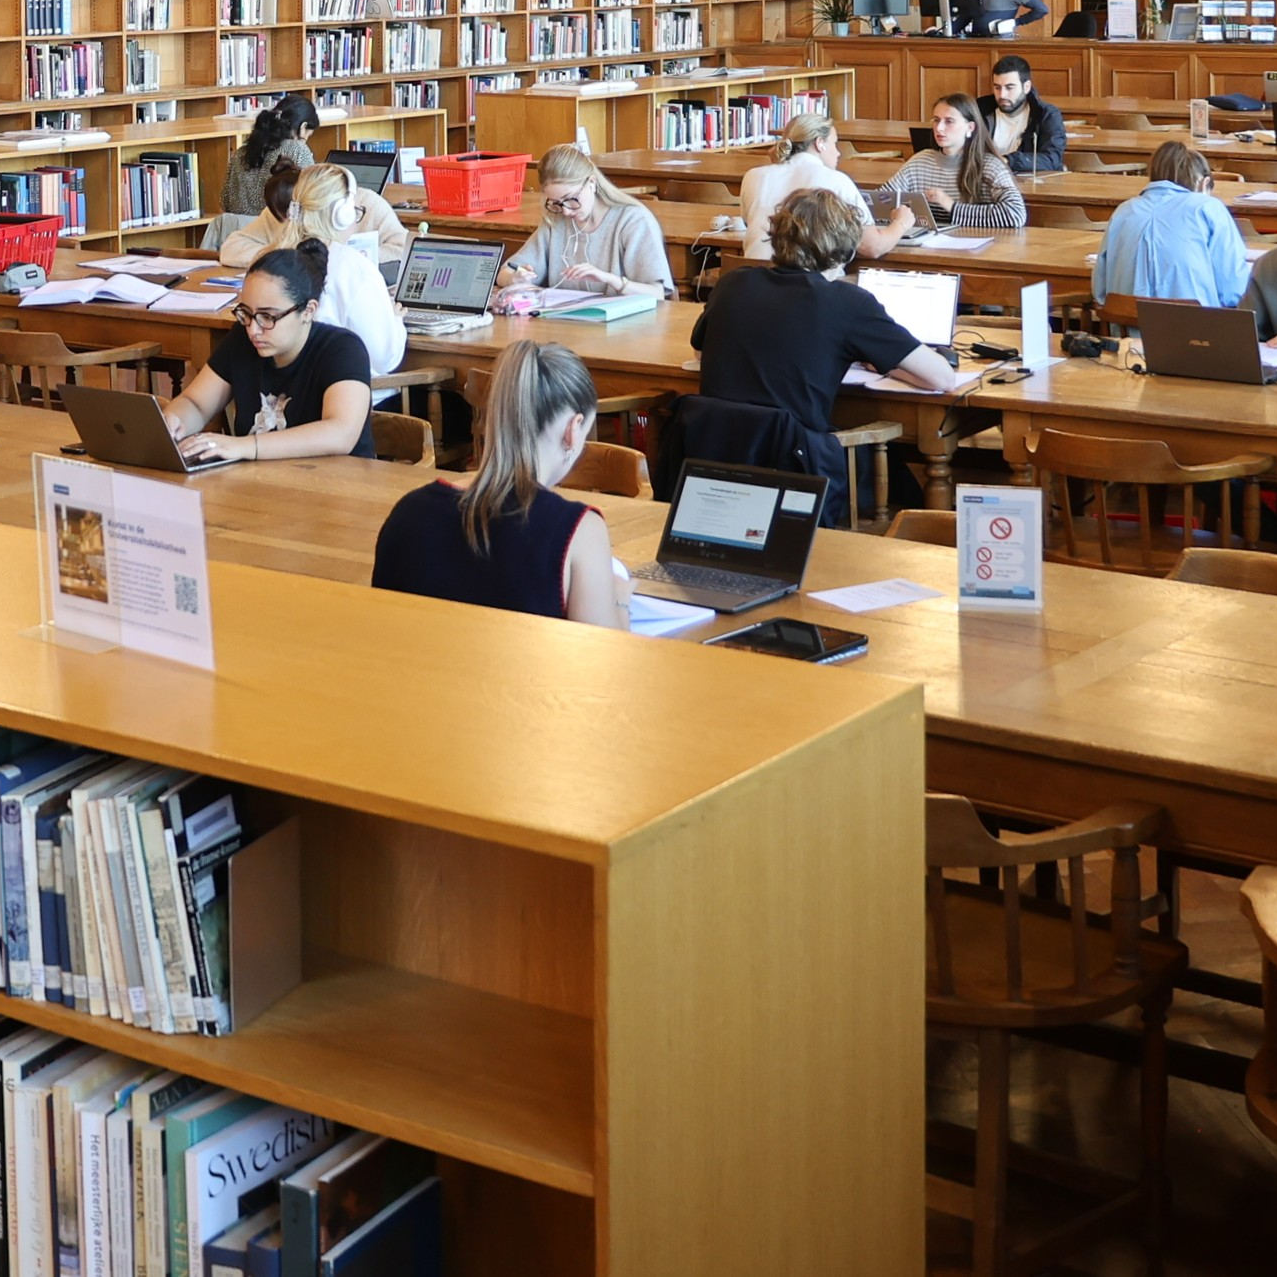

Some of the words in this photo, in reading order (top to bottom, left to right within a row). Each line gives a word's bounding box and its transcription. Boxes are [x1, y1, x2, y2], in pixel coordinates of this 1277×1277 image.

[90, 1134, 101, 1157] Het
[207, 1114, 331, 1199] Swedish
[89, 1158, 103, 1237] meesterlijke
